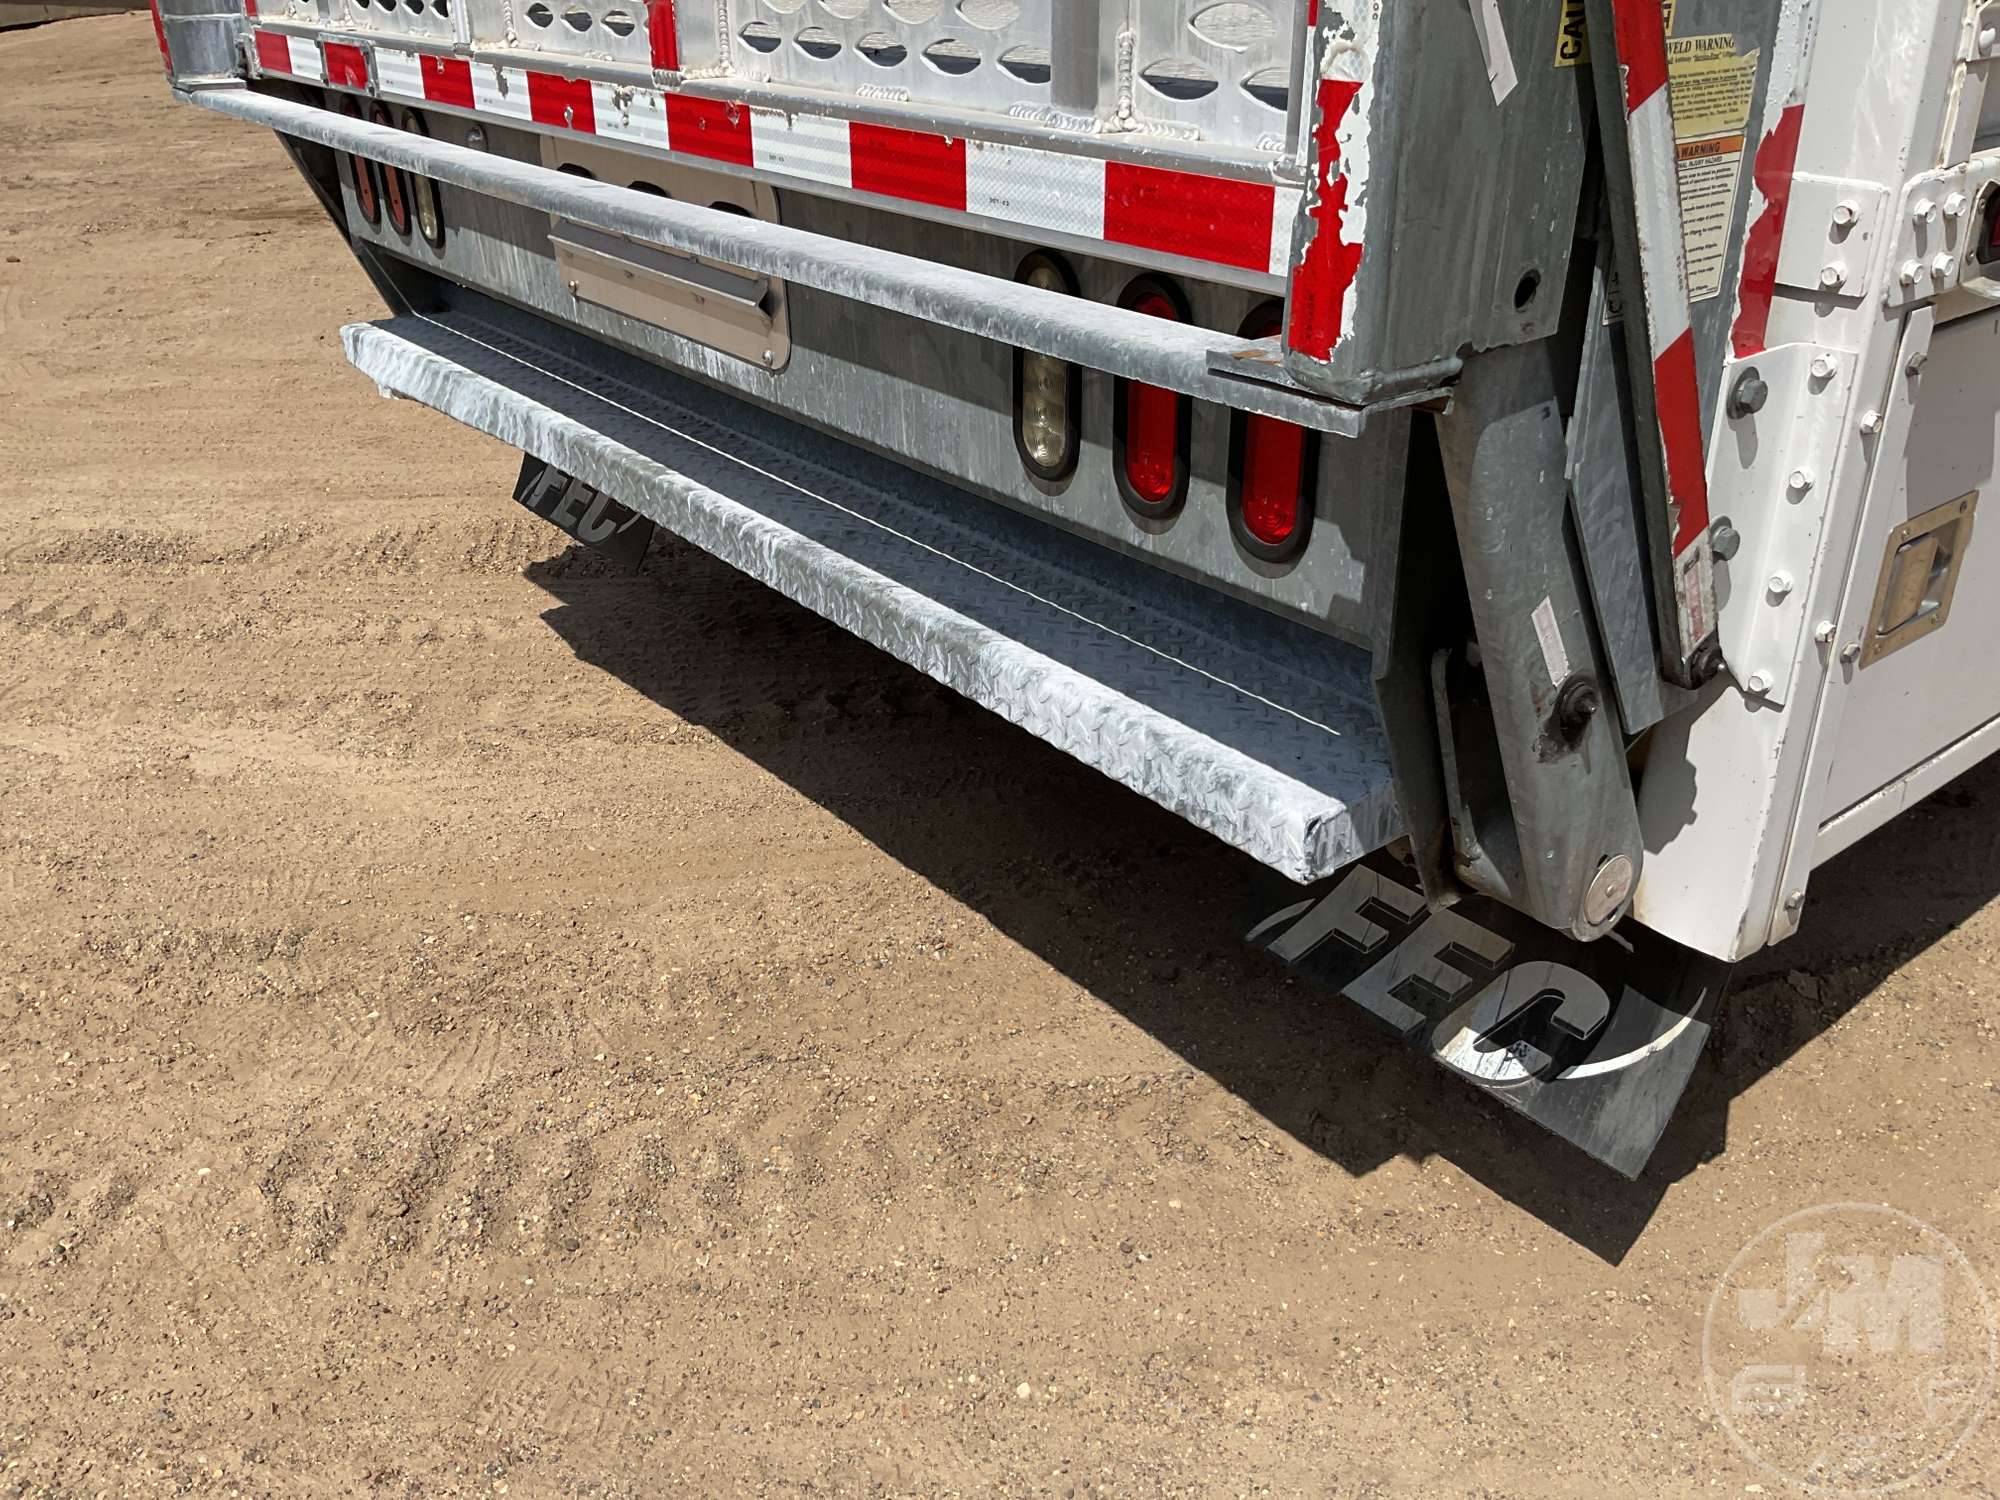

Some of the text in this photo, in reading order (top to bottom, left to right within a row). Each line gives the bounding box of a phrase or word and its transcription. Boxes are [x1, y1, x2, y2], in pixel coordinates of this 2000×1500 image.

[1695, 36, 1735, 51] WARNING
[1681, 141, 1720, 157] WARNING
[526, 463, 627, 542] FEC
[1265, 864, 1610, 1088] FEC
